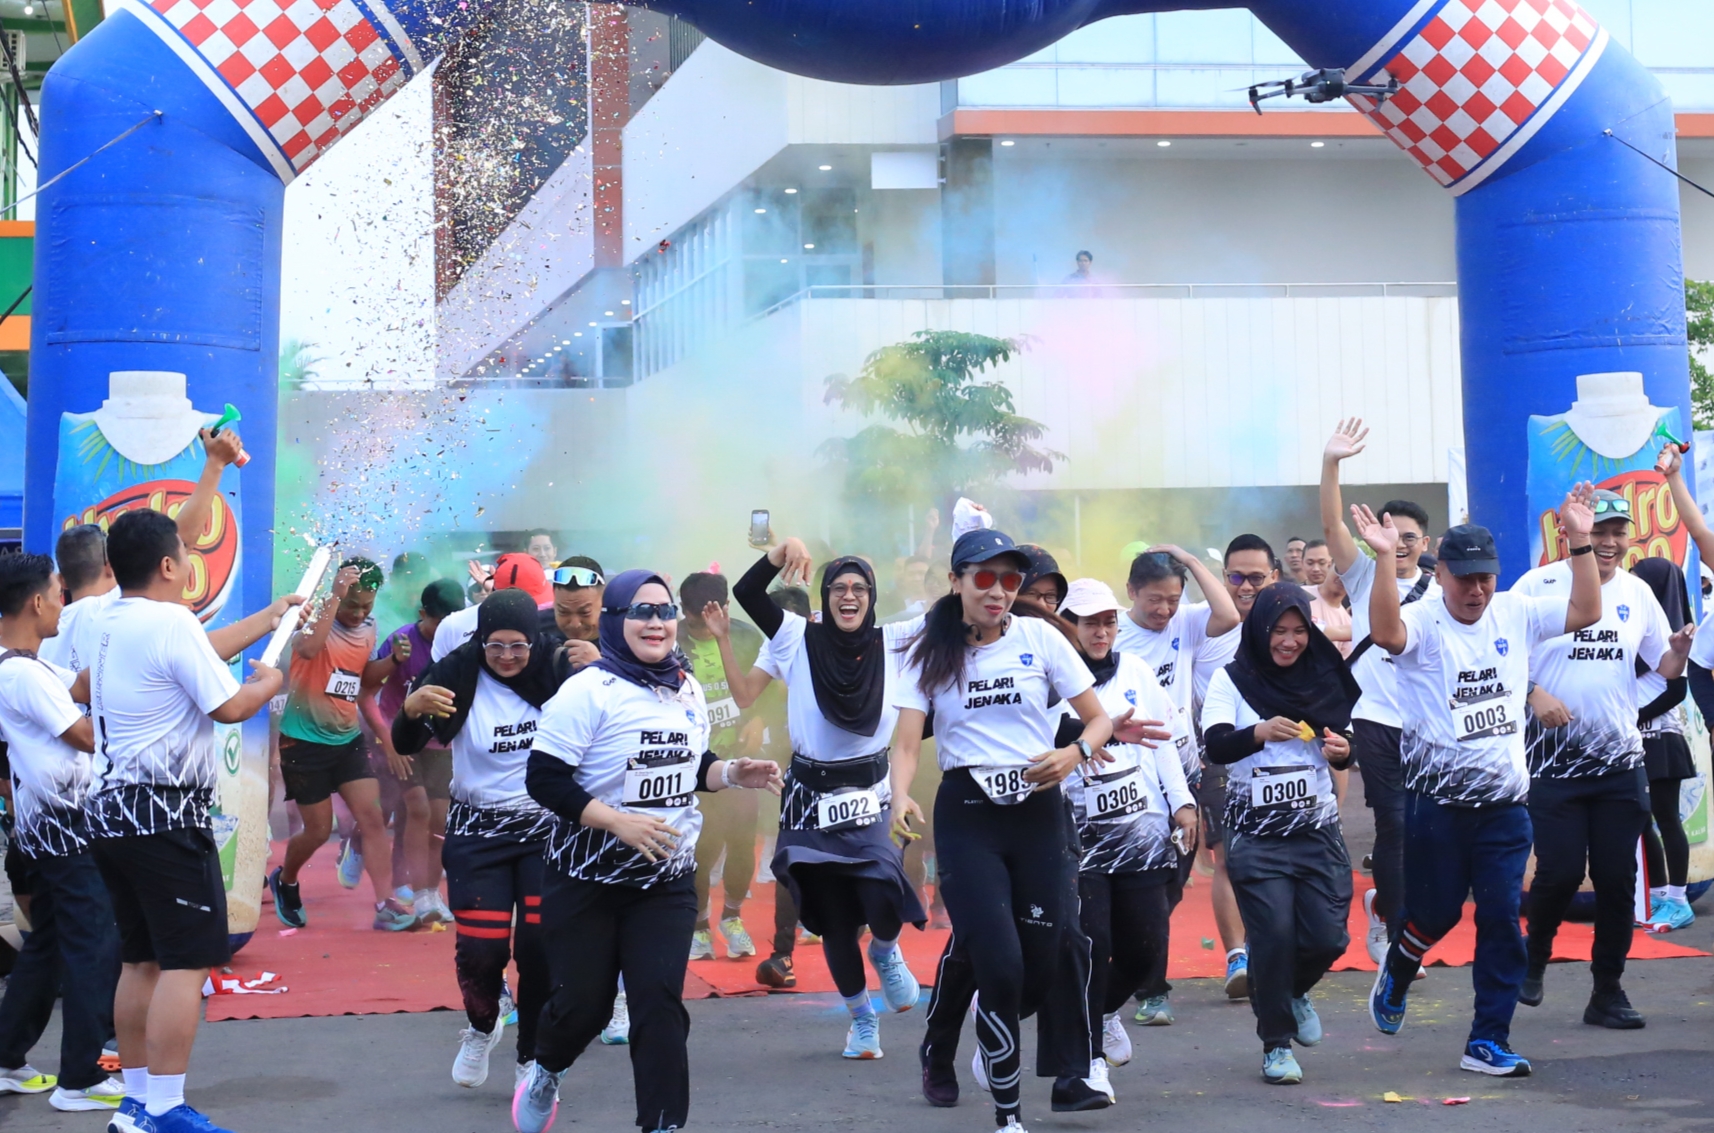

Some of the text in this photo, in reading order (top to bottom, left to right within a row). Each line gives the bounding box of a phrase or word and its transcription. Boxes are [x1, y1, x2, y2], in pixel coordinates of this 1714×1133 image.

[1567, 647, 1624, 661] JENAKA
[334, 680, 357, 695] 0215
[1453, 682, 1505, 699] JENAKA
[964, 692, 1022, 710] JENAKA
[707, 704, 730, 724] 091
[1463, 704, 1507, 734] 0003
[488, 736, 535, 754] JENAK
[638, 771, 682, 801] 0011
[1262, 778, 1307, 805] 0300
[1096, 780, 1138, 813] 0306
[828, 796, 870, 824] 0022
